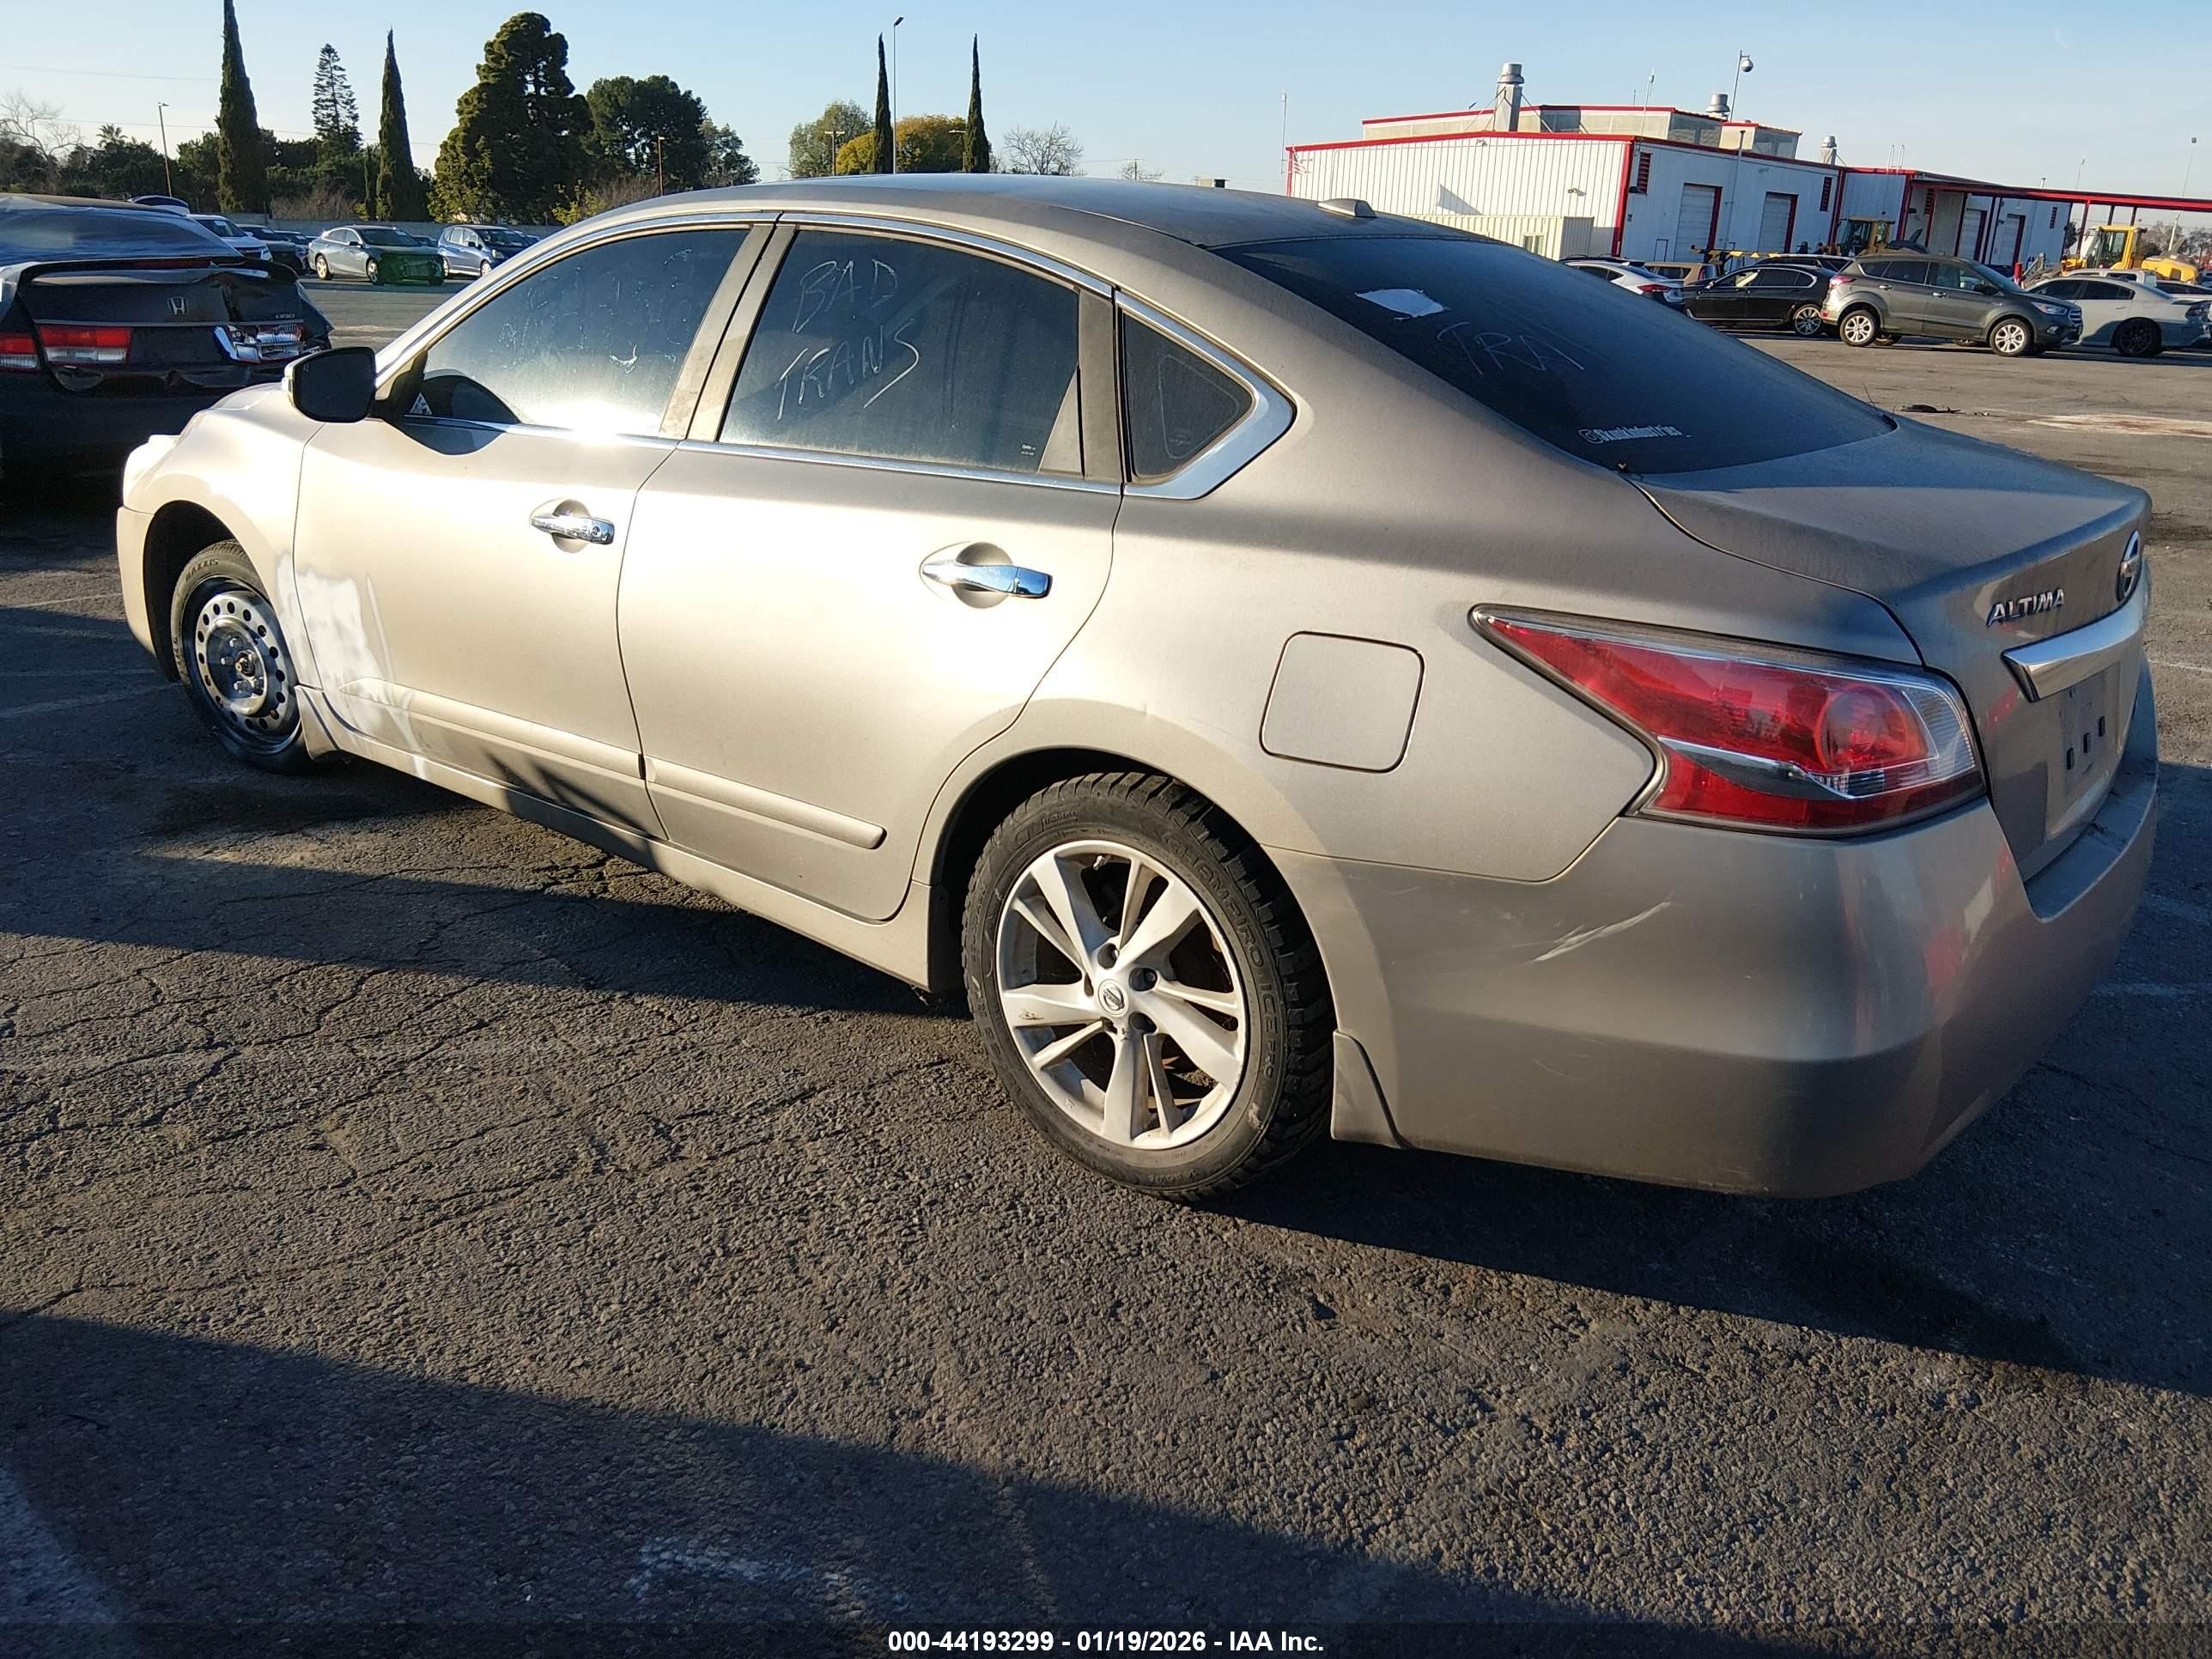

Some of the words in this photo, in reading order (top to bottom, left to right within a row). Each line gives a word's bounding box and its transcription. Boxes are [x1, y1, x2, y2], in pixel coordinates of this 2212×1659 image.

[791, 258, 899, 333] BAD
[775, 317, 921, 422] TRANS
[1436, 320, 1585, 376] TRA
[1986, 587, 2065, 628] ALTIMA
[1161, 831, 1265, 968] CHAMPIRO
[1260, 982, 1279, 1035] ICE
